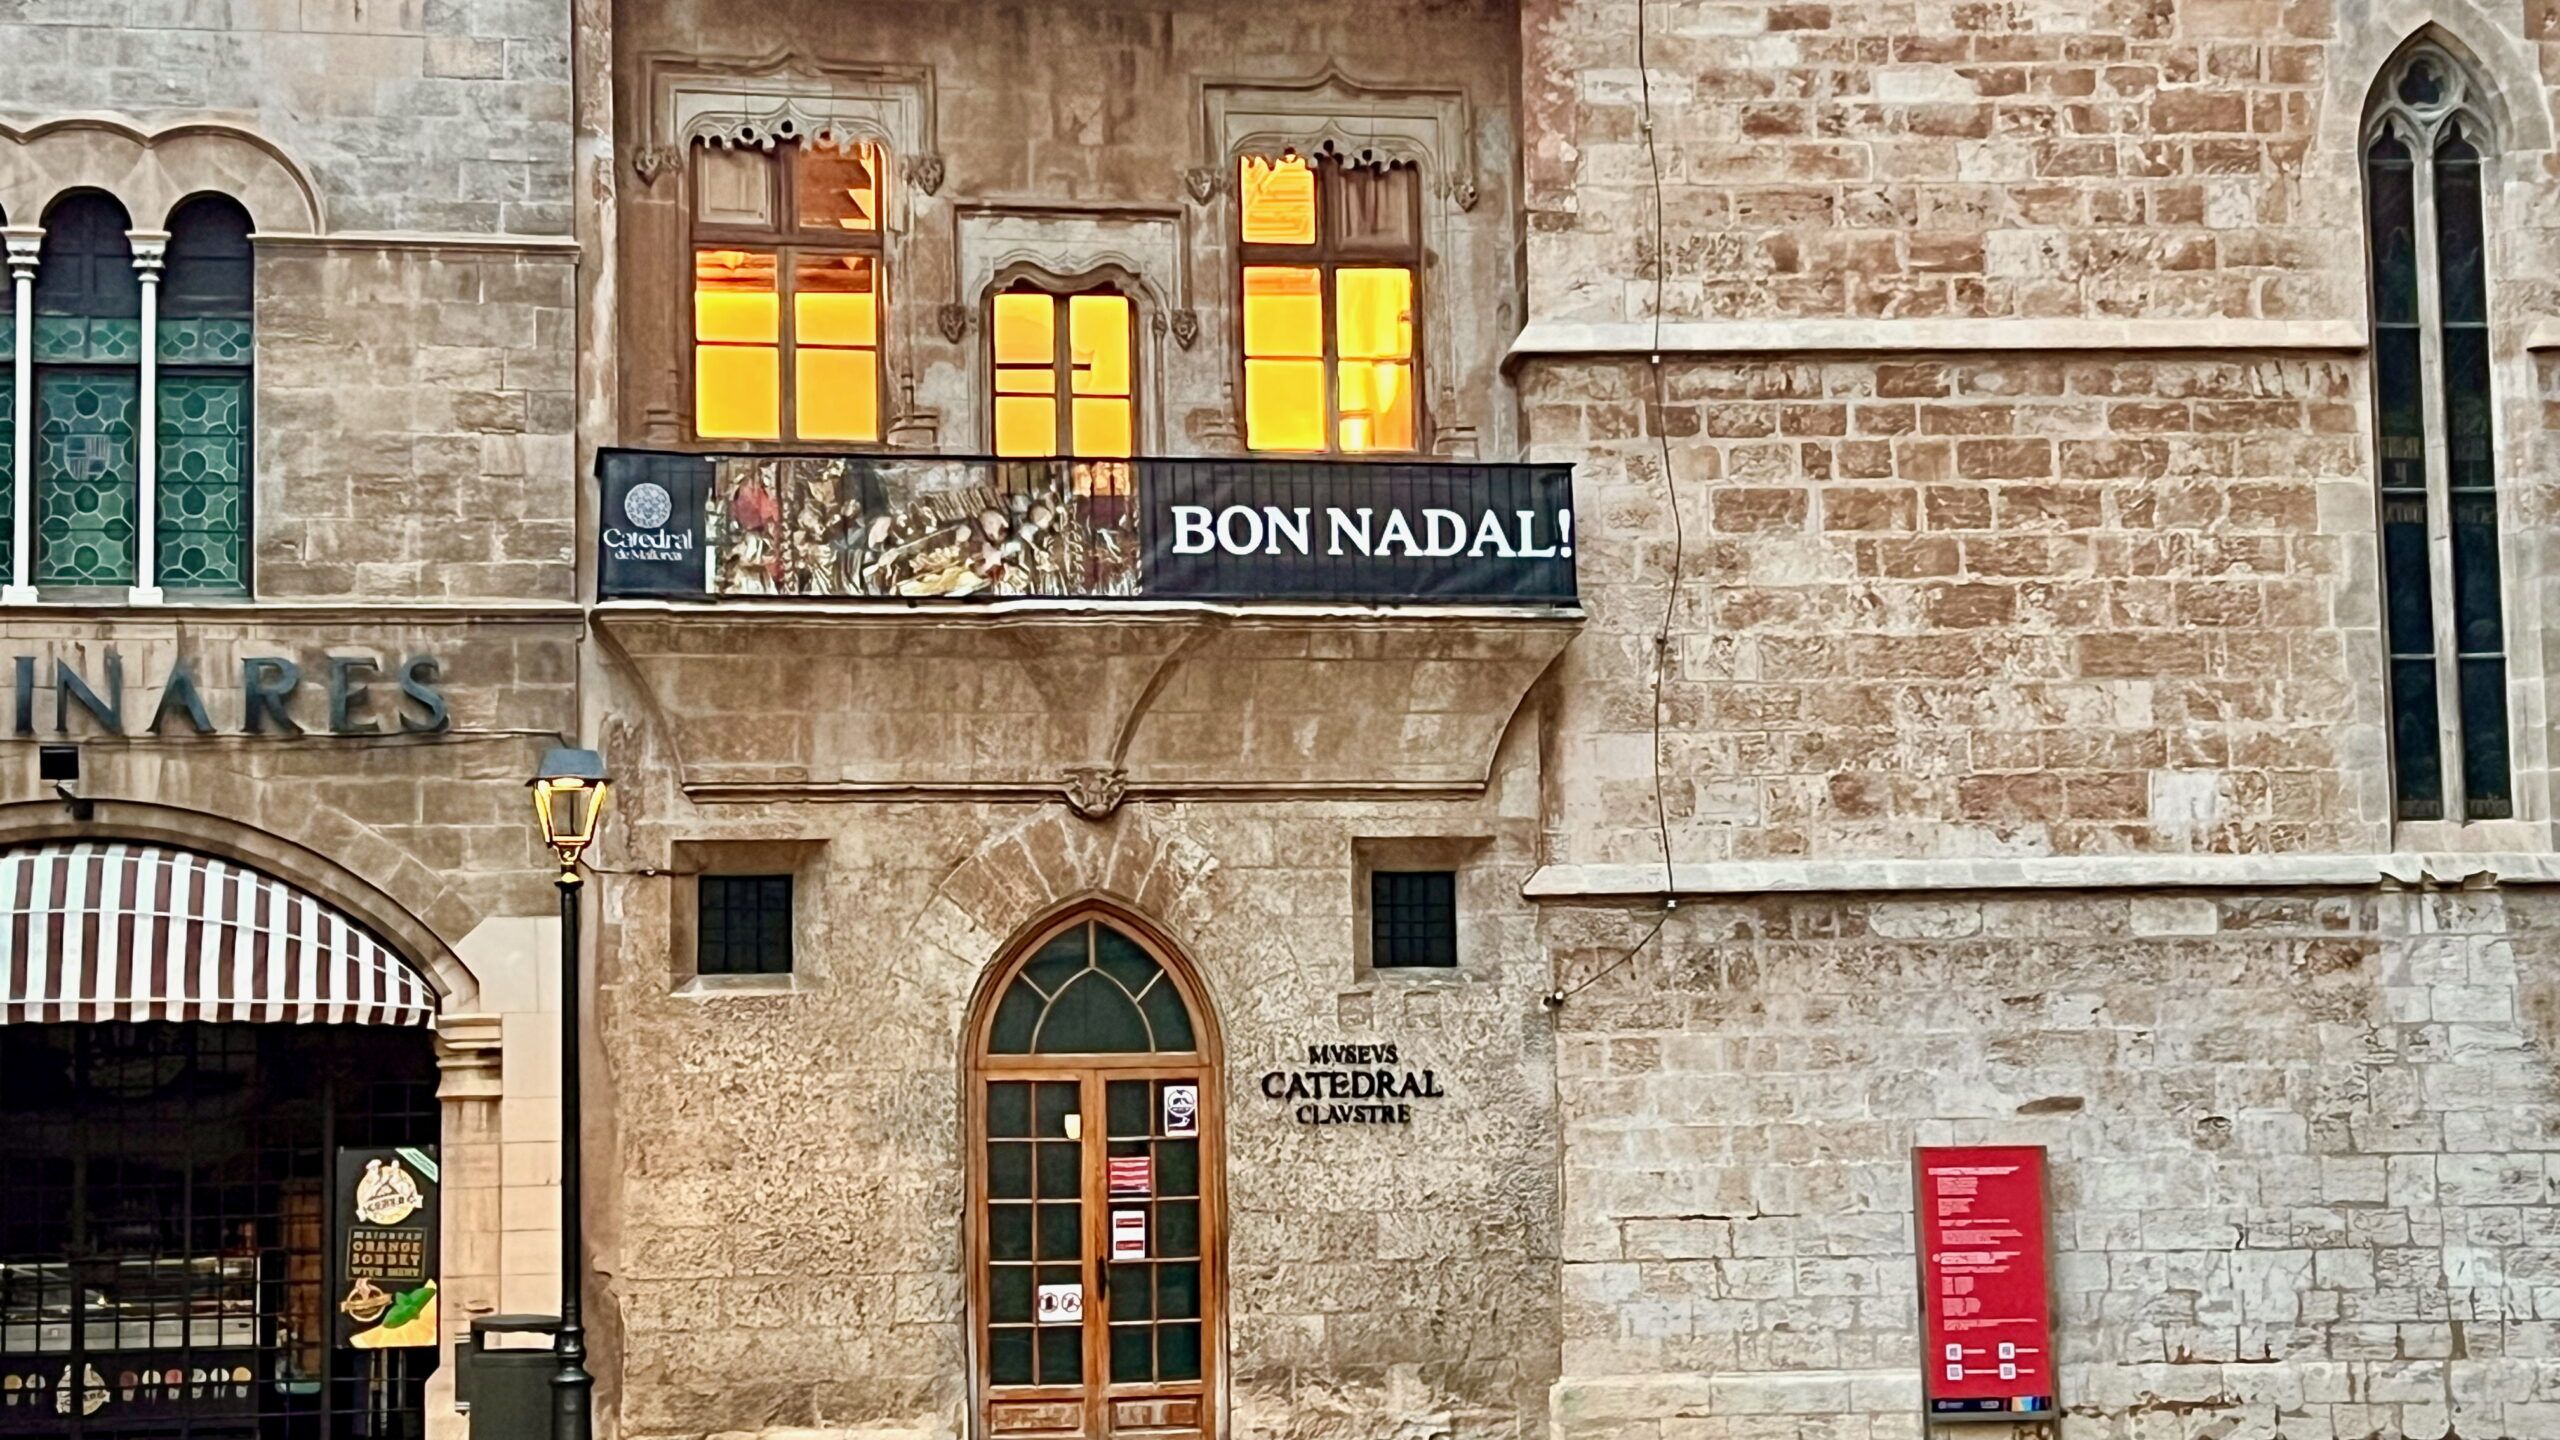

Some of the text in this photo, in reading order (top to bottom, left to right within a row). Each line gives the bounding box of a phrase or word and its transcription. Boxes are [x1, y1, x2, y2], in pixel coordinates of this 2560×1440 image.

[603, 528, 693, 550] Catedral
[1171, 505, 1572, 559] BON NADAL!
[13, 653, 449, 735] INARES
[1261, 1069, 1444, 1101] CATEDRAL
[352, 1241, 421, 1253] ORANGE
